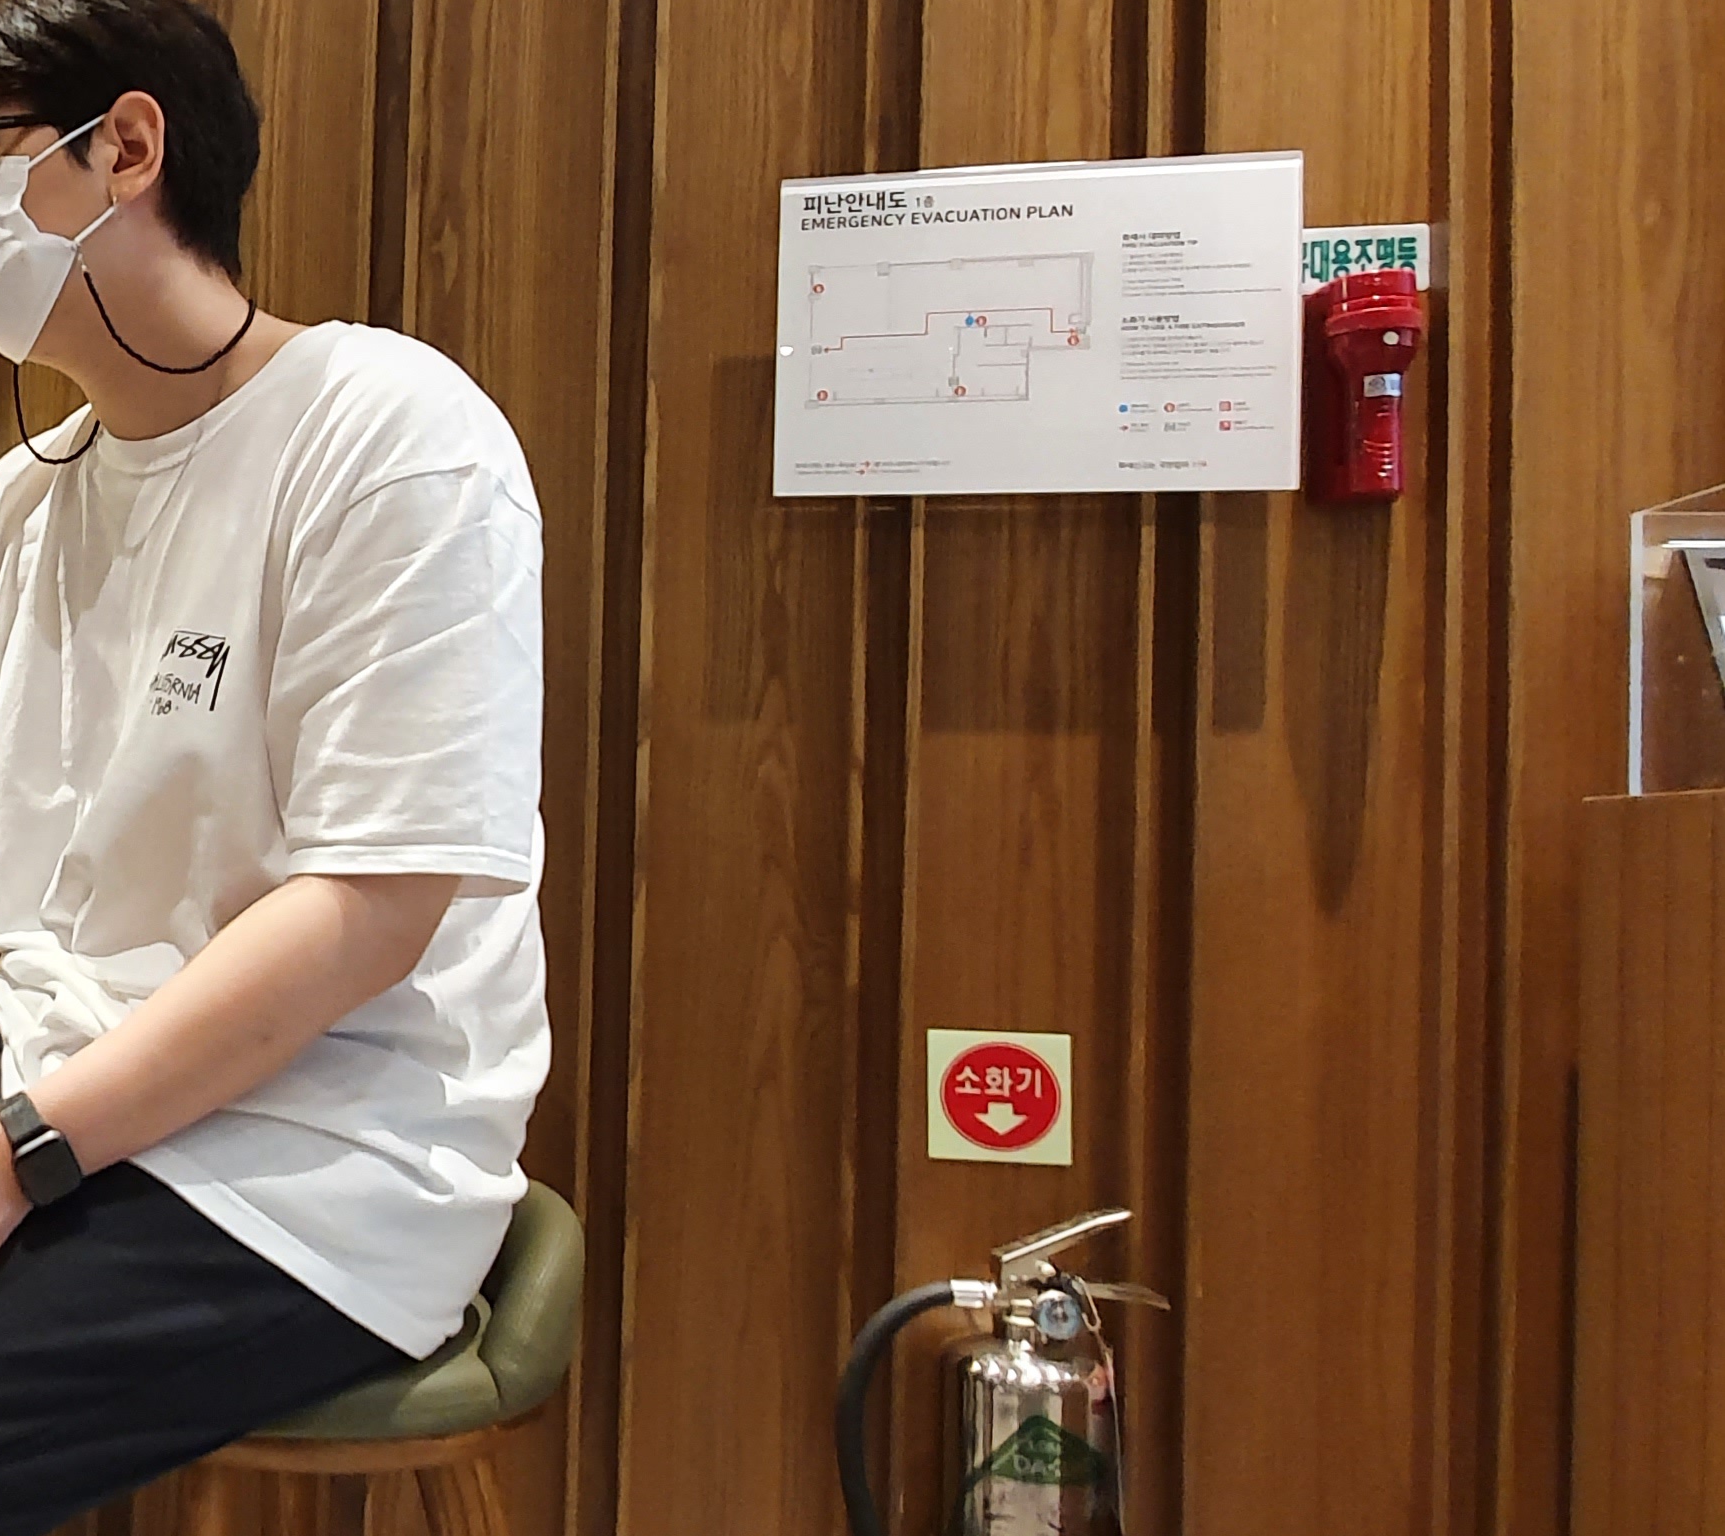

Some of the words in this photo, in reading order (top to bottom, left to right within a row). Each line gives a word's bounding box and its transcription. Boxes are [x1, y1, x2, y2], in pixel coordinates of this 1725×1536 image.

[803, 190, 908, 215] 피난안내도
[800, 213, 906, 231] EMERGENCY
[910, 207, 1022, 226] EVACUATION
[1026, 204, 1075, 220] PLAN
[954, 1065, 1043, 1099] 소화기
